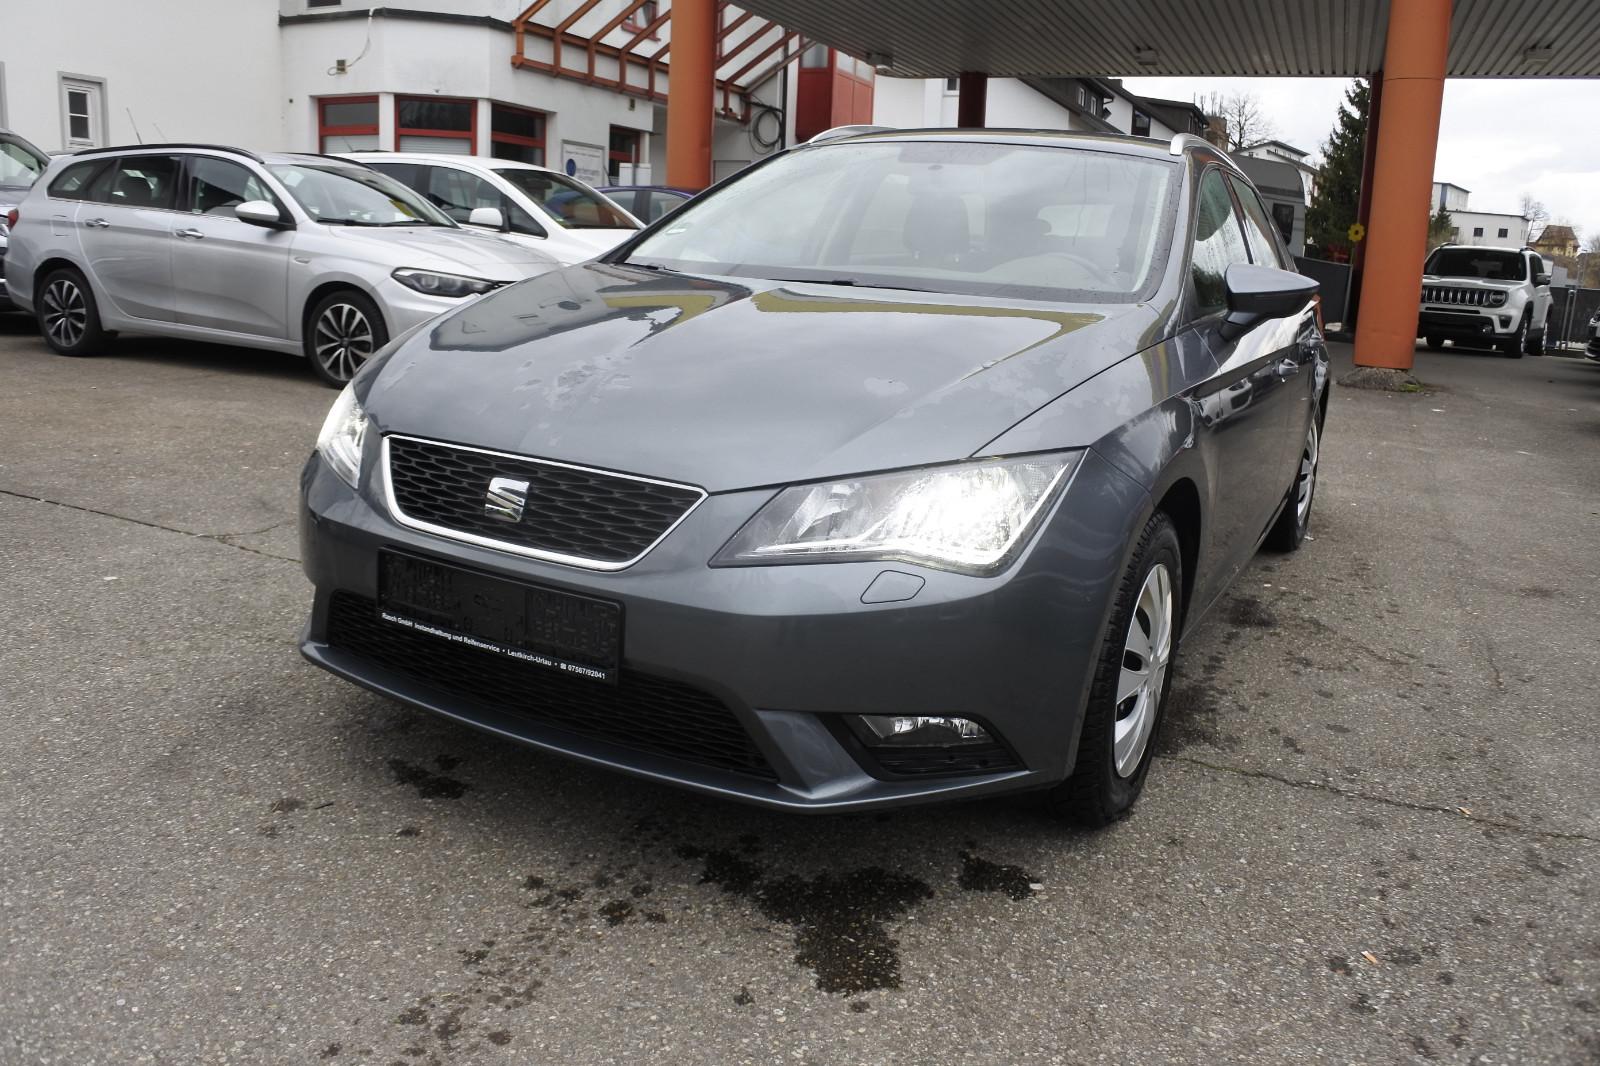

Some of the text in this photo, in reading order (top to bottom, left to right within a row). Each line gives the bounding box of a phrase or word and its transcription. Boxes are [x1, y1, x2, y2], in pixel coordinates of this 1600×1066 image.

[398, 617, 413, 627] GmbH
[452, 634, 463, 642] und
[463, 636, 500, 653] Reifenservice
[507, 648, 552, 666] Leutkirch-Urlau
